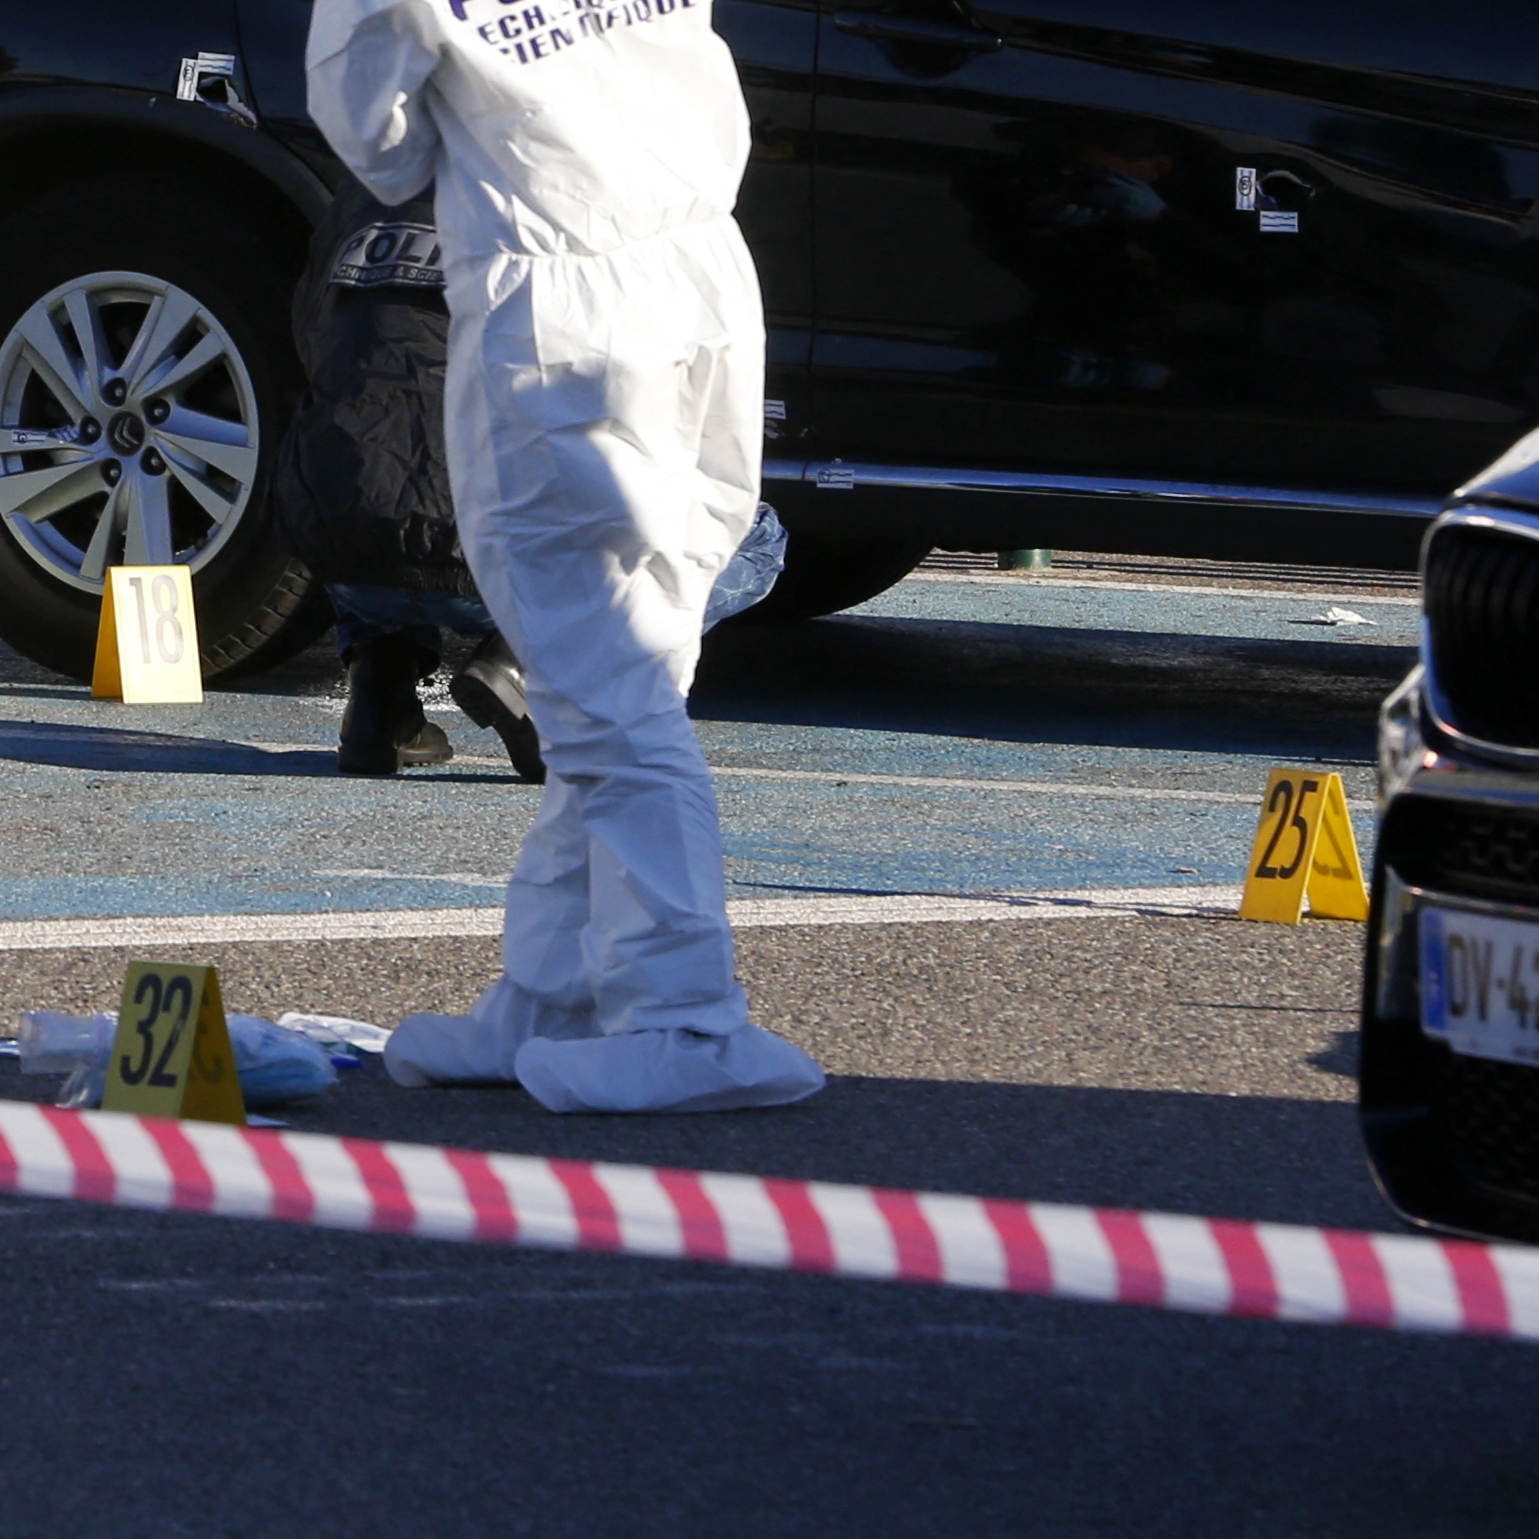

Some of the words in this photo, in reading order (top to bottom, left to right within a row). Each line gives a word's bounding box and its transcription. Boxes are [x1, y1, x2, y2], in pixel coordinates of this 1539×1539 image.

[129, 574, 184, 664] 18
[1254, 779, 1319, 880] 25
[121, 973, 194, 1088] 32
